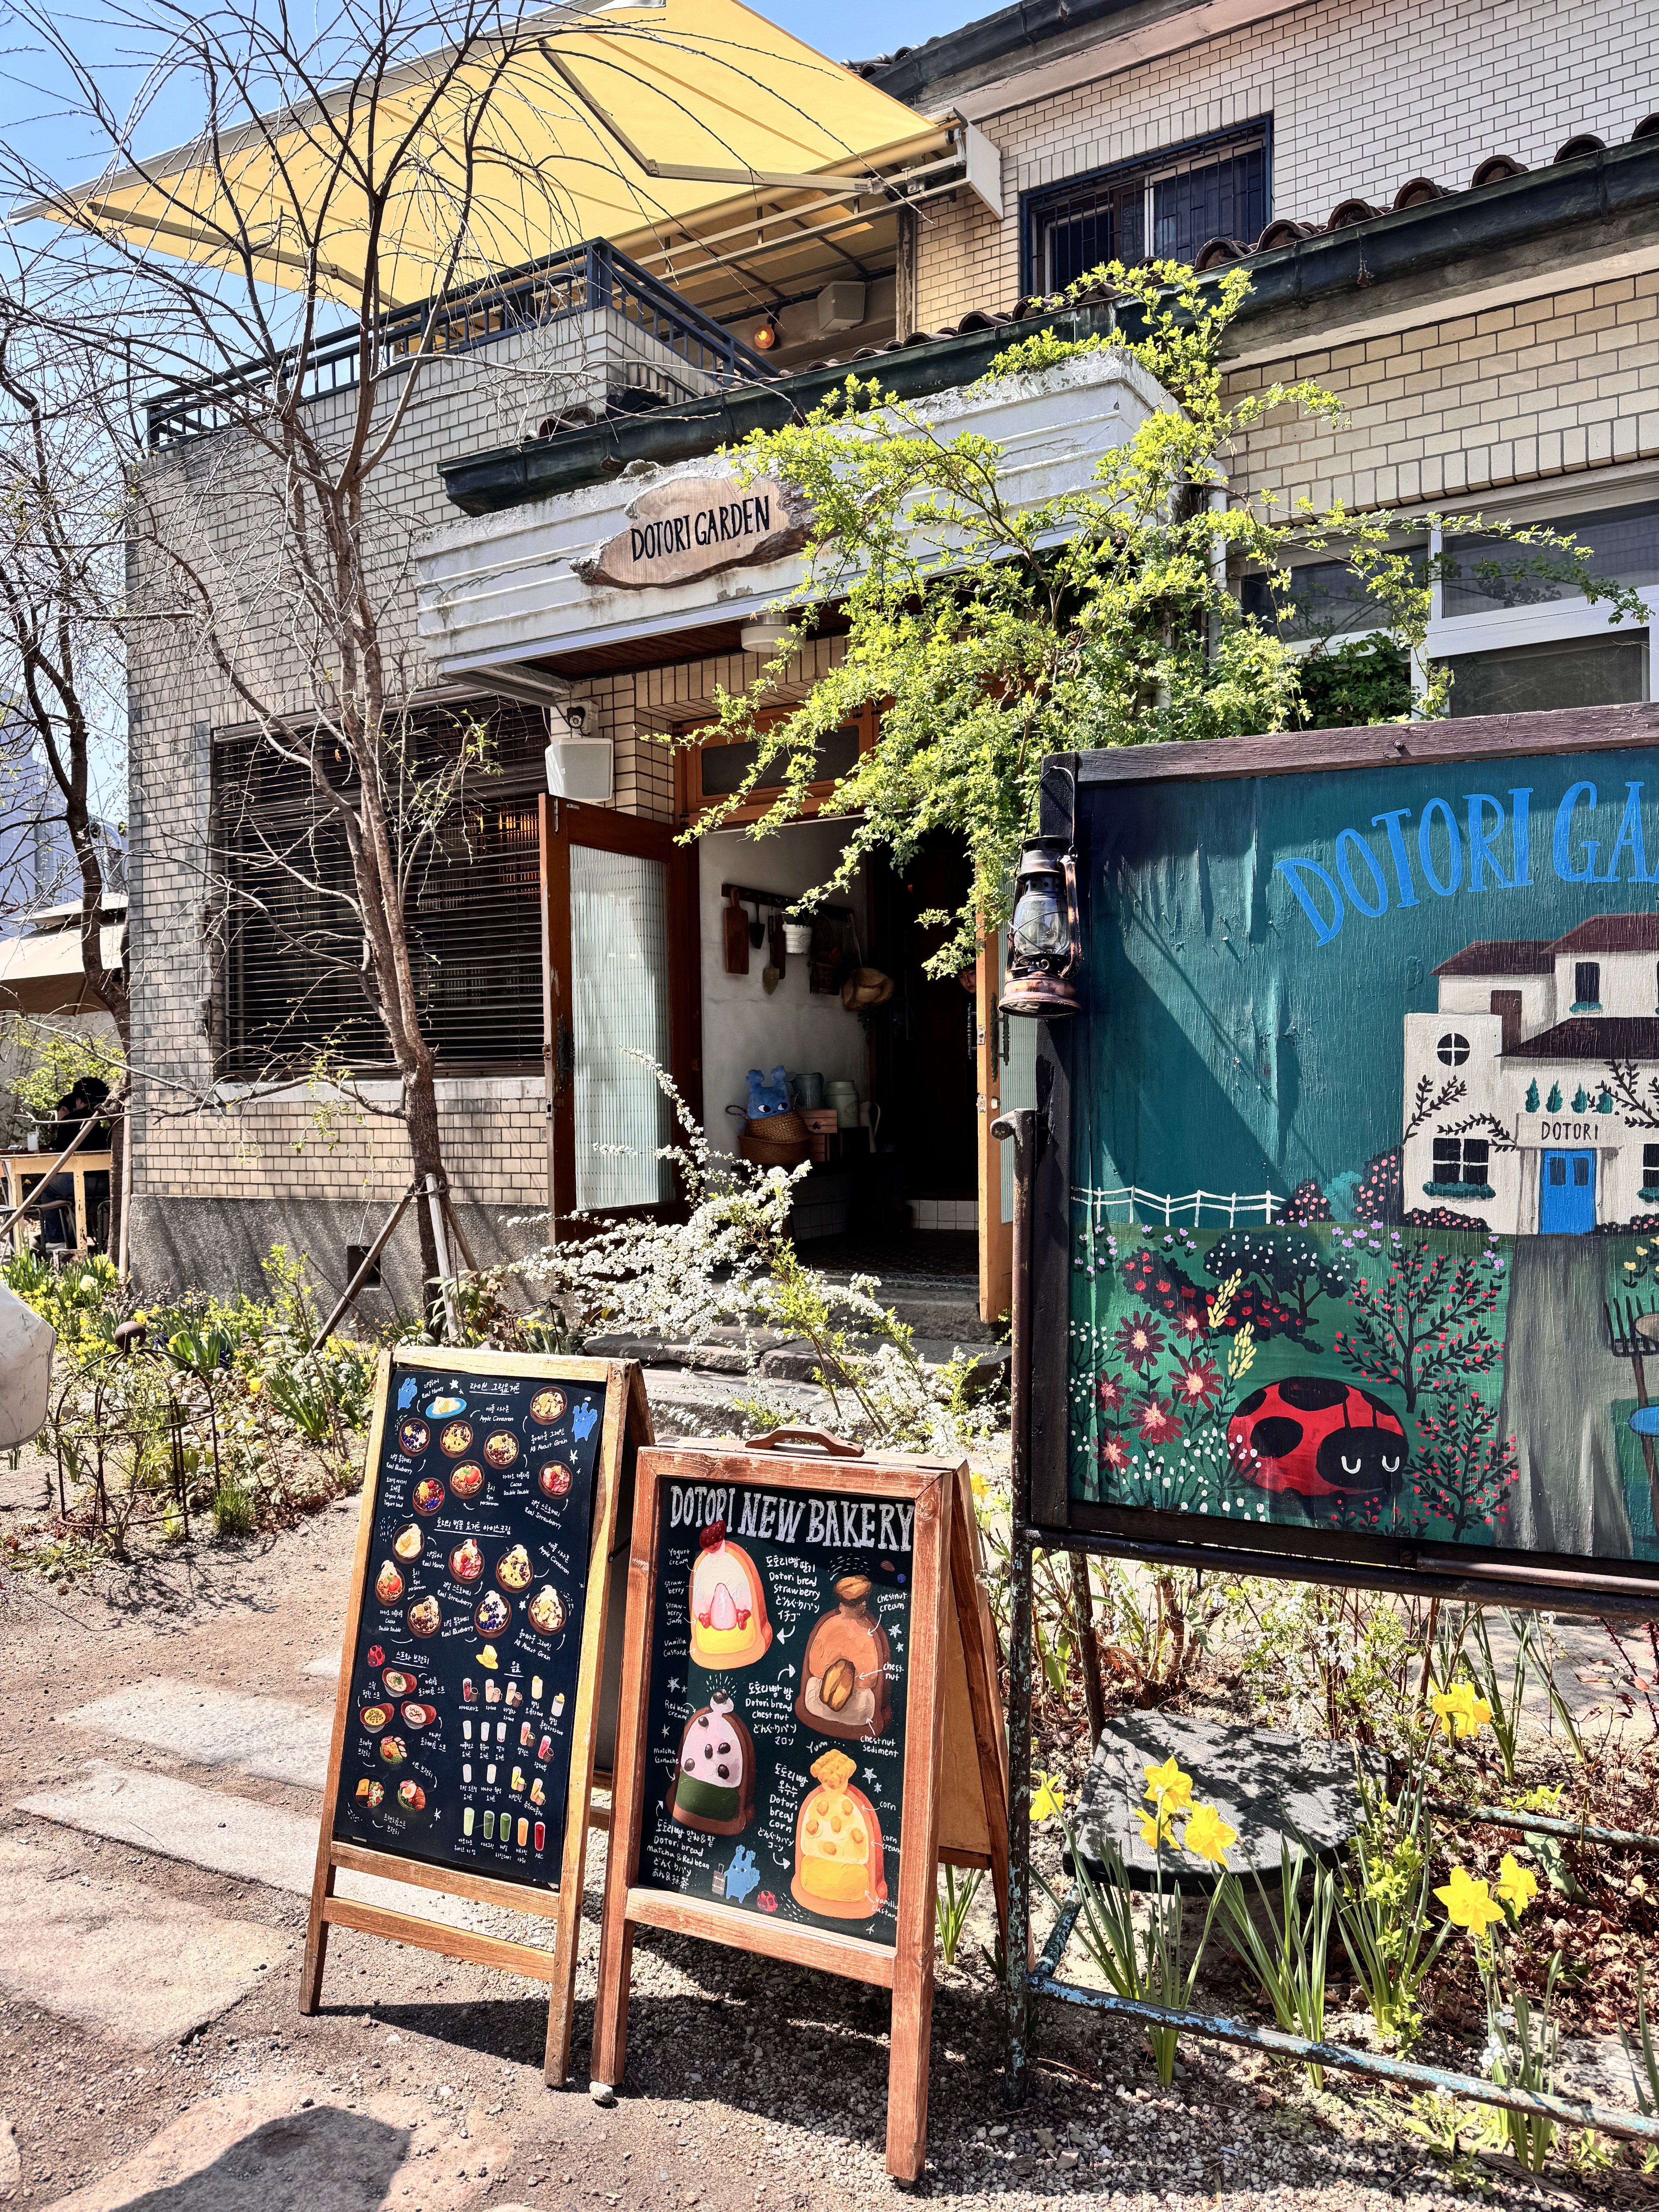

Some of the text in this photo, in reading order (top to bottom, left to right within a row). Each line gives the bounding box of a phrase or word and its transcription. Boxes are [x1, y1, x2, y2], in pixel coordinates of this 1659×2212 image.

[630, 495, 770, 562] DOTORI GARDEN
[1274, 781, 1659, 946] DOTORI GA
[1541, 1121, 1599, 1140] DOTORI
[479, 1415, 491, 1423] Apple
[538, 1442, 552, 1451] About
[525, 1507, 562, 1530] Real Strawberry
[670, 1486, 915, 1551] DOTORI NEW BAKERY
[539, 1546, 570, 1575] Apple Cinnamon
[668, 1548, 690, 1559] Yogurt
[432, 1561, 445, 1570] Honey
[766, 1555, 815, 1573] 도토리빵 딸기
[769, 1571, 817, 1587] Dotori bread
[437, 1589, 473, 1609] Real Strawberry
[774, 1583, 820, 1601] Strawberry
[877, 1592, 907, 1604] chestnut
[776, 1595, 819, 1613] どんぐりパン
[879, 1603, 904, 1612] cream
[668, 1609, 682, 1619] berry
[777, 1610, 800, 1622] イチゴ
[664, 1637, 687, 1646] Vanilla
[521, 1642, 536, 1654] About
[537, 1650, 551, 1661] Grain
[663, 1649, 687, 1657] Custard
[885, 1673, 900, 1681] nut
[749, 1681, 793, 1701] 도토리빵 밤
[665, 1699, 689, 1714] Red bean
[745, 1698, 792, 1712] Dotori bread
[668, 1711, 687, 1720] cream
[753, 1723, 797, 1734] どんぐりパン
[775, 1736, 794, 1745] マロン
[860, 1735, 896, 1747] chestnut
[863, 1745, 899, 1757] sediment
[655, 1756, 679, 1764] Ganache
[775, 1763, 809, 1789] 도토리빵
[778, 1780, 798, 1798] 옥수수
[769, 1794, 798, 1810] Dotori
[879, 1801, 896, 1811] corn
[769, 1806, 793, 1823] bread
[386, 1825, 399, 1836] 브런치
[656, 1819, 685, 1839] 도토리빵
[757, 1826, 794, 1847] どんぐりパン
[883, 1835, 897, 1844] corn
[654, 1836, 704, 1857] Dotori bread
[768, 1842, 783, 1852] コーン
[647, 1845, 675, 1858] Matcha
[694, 1858, 709, 1870] bean
